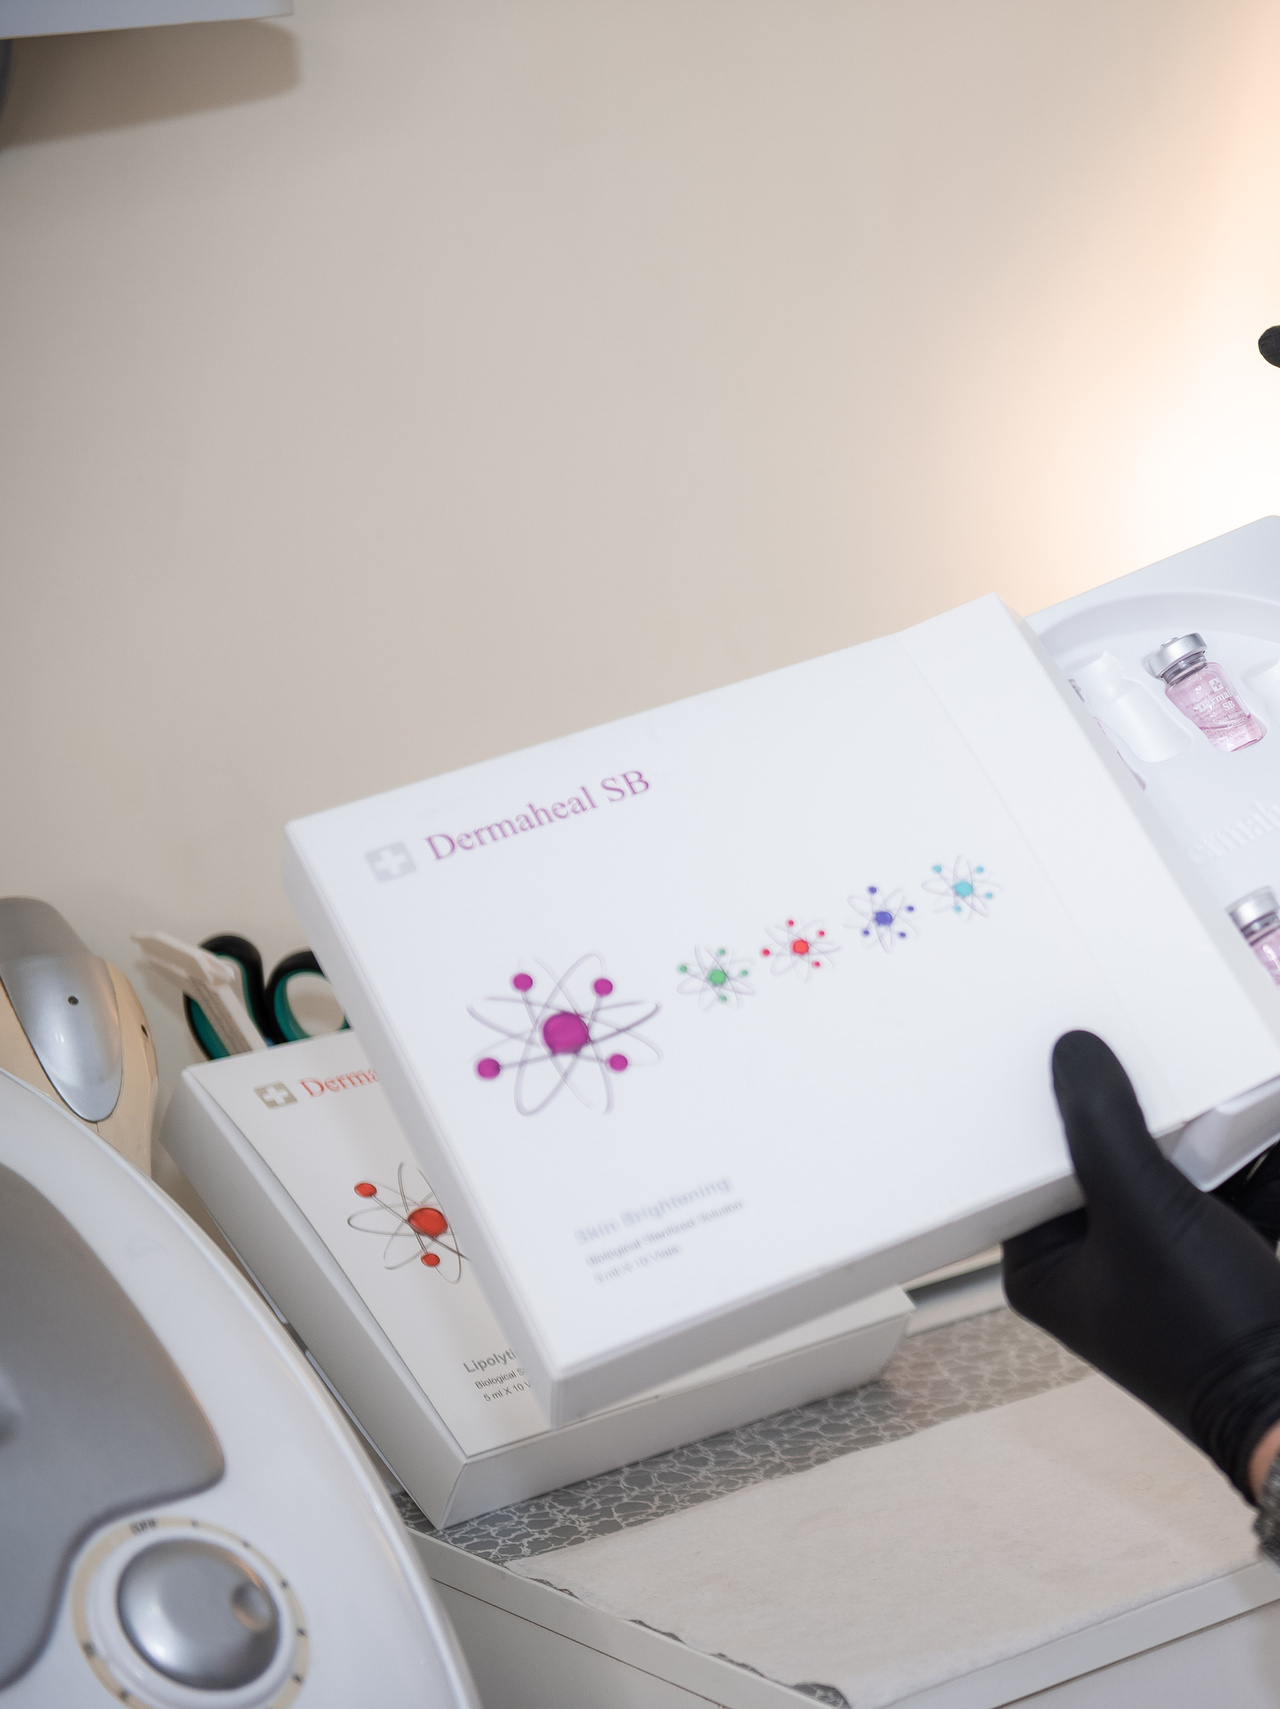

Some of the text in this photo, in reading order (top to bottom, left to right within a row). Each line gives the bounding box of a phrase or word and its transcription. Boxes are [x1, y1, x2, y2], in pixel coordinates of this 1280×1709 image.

[424, 770, 650, 860] Dermaheal SB
[475, 1370, 517, 1389] Biological
[492, 1390, 503, 1400] ml
[503, 1386, 512, 1396] X
[513, 1382, 525, 1392] 10
